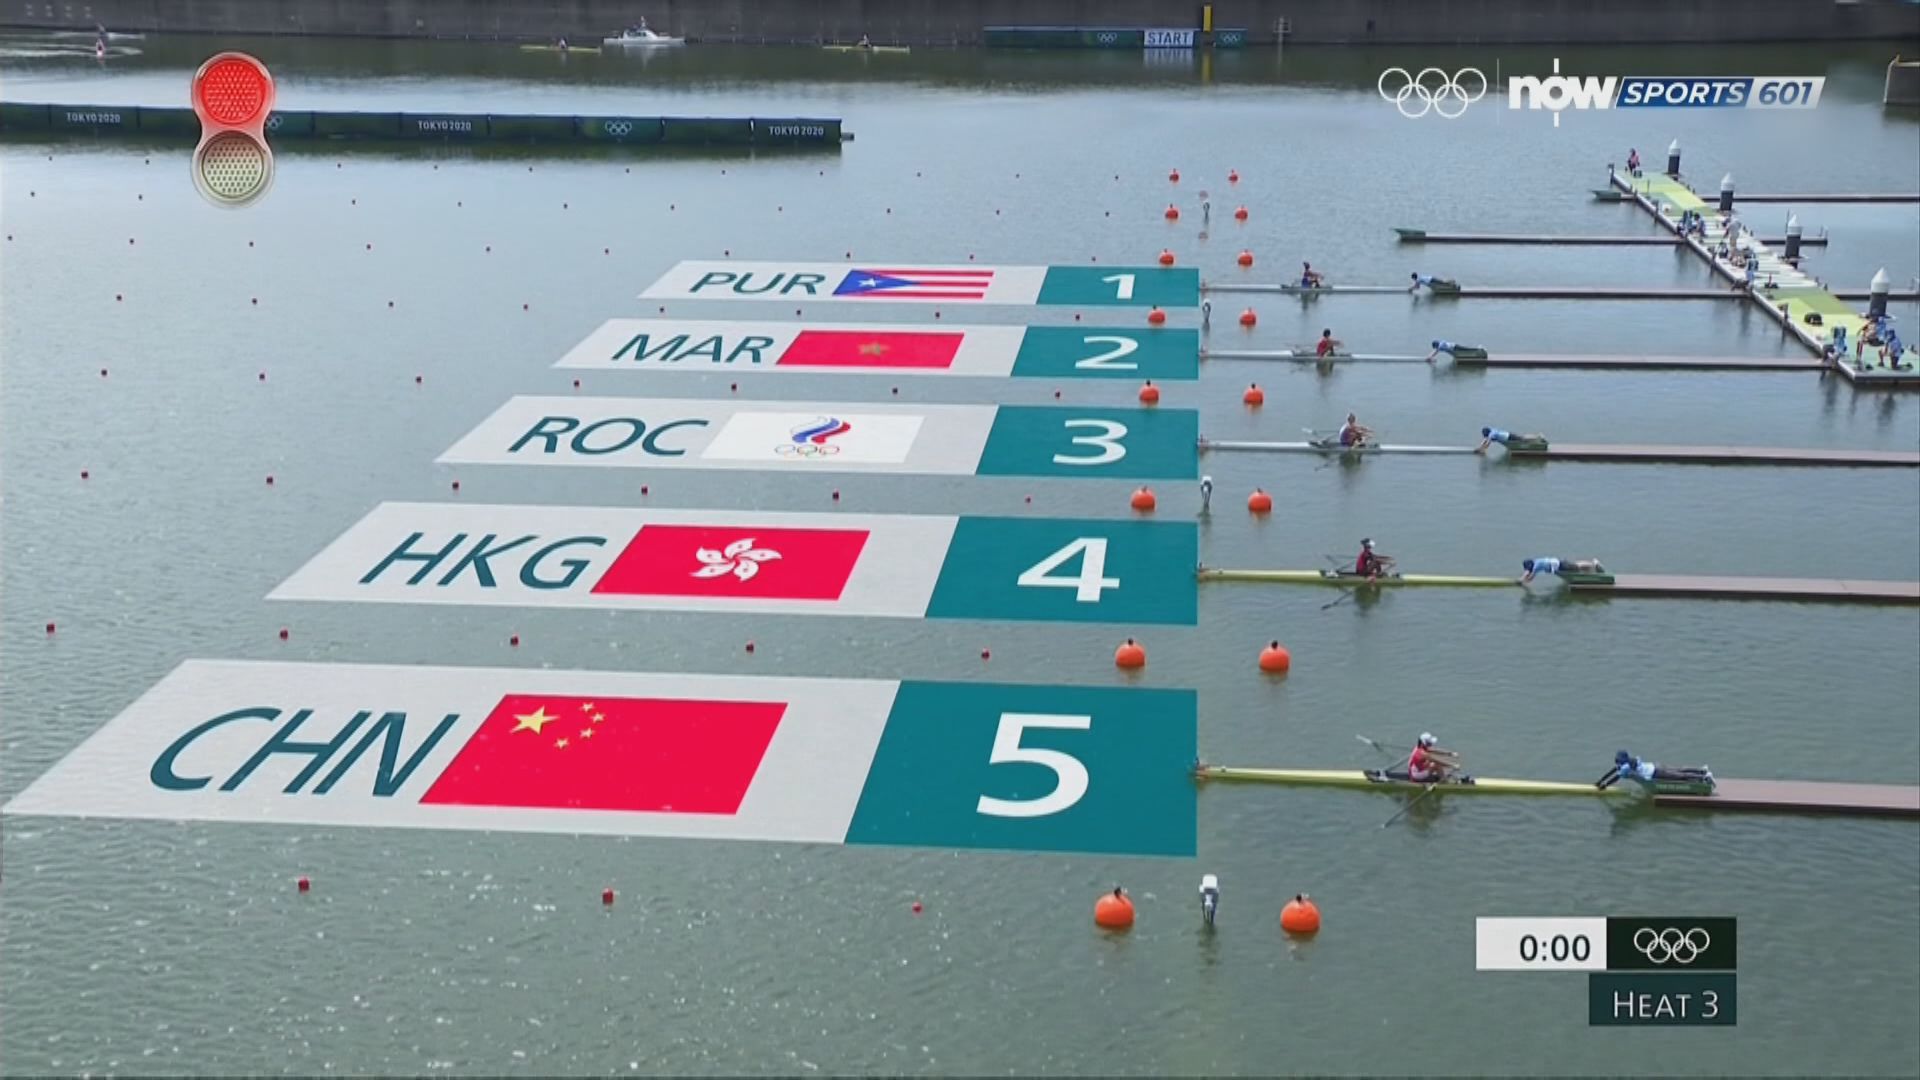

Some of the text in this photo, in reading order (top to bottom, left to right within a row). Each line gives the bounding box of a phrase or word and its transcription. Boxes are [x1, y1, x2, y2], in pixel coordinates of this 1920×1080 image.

[1148, 31, 1189, 44] START
[67, 112, 121, 123] TOKYO 2020
[418, 120, 472, 131] TOKYO 2020
[769, 126, 824, 136] TOKYO 2020
